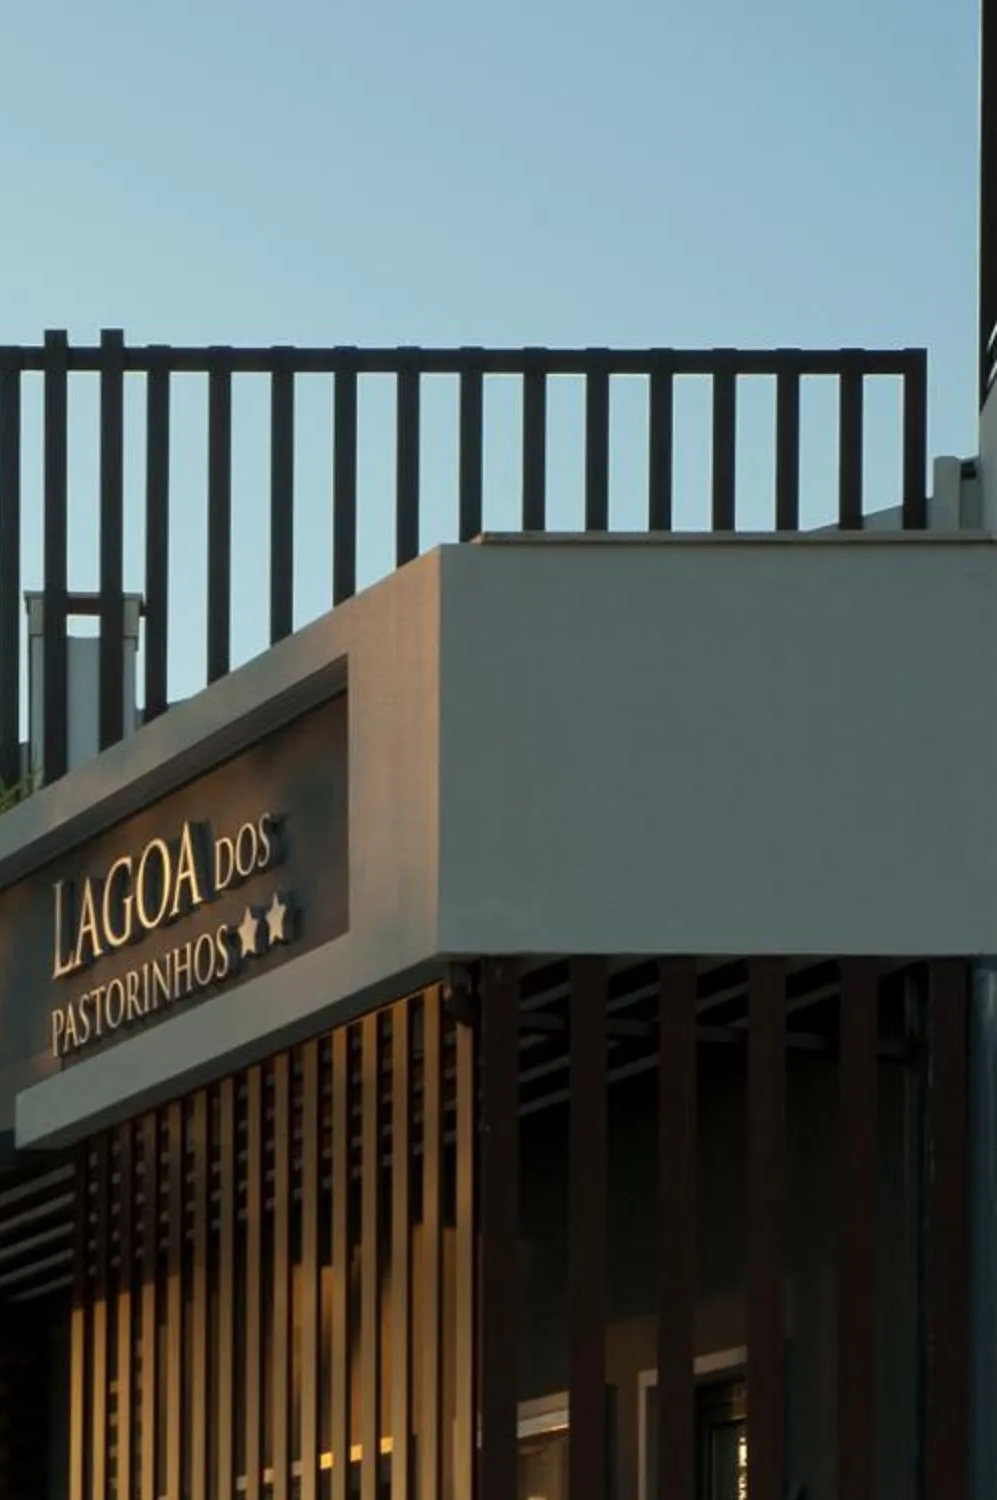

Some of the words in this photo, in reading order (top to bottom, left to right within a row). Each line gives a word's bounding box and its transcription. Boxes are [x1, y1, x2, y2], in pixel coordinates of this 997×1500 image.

[53, 820, 203, 980] LAGOA
[214, 812, 271, 891] DOS
[52, 923, 230, 1057] PASTORINHOS
